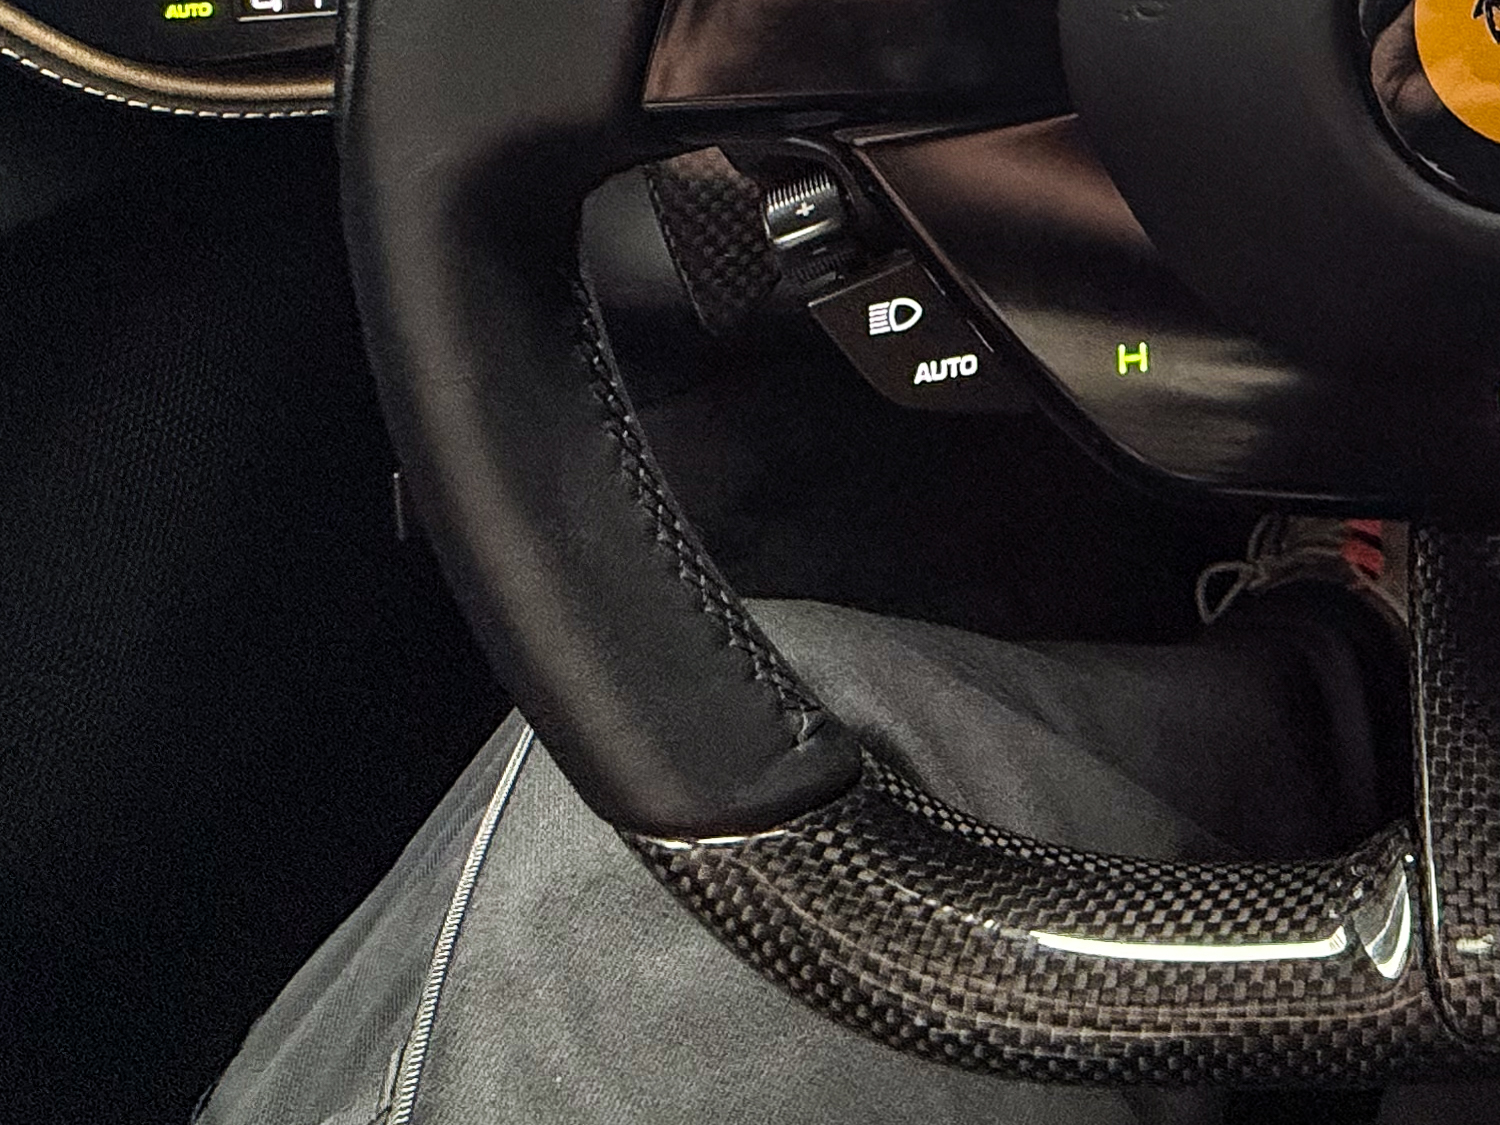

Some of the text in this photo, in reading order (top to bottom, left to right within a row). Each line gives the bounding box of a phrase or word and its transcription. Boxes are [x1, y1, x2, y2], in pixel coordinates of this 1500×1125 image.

[165, 2, 213, 19] AUTO
[913, 354, 979, 385] AUTO
[1118, 342, 1148, 375] H
